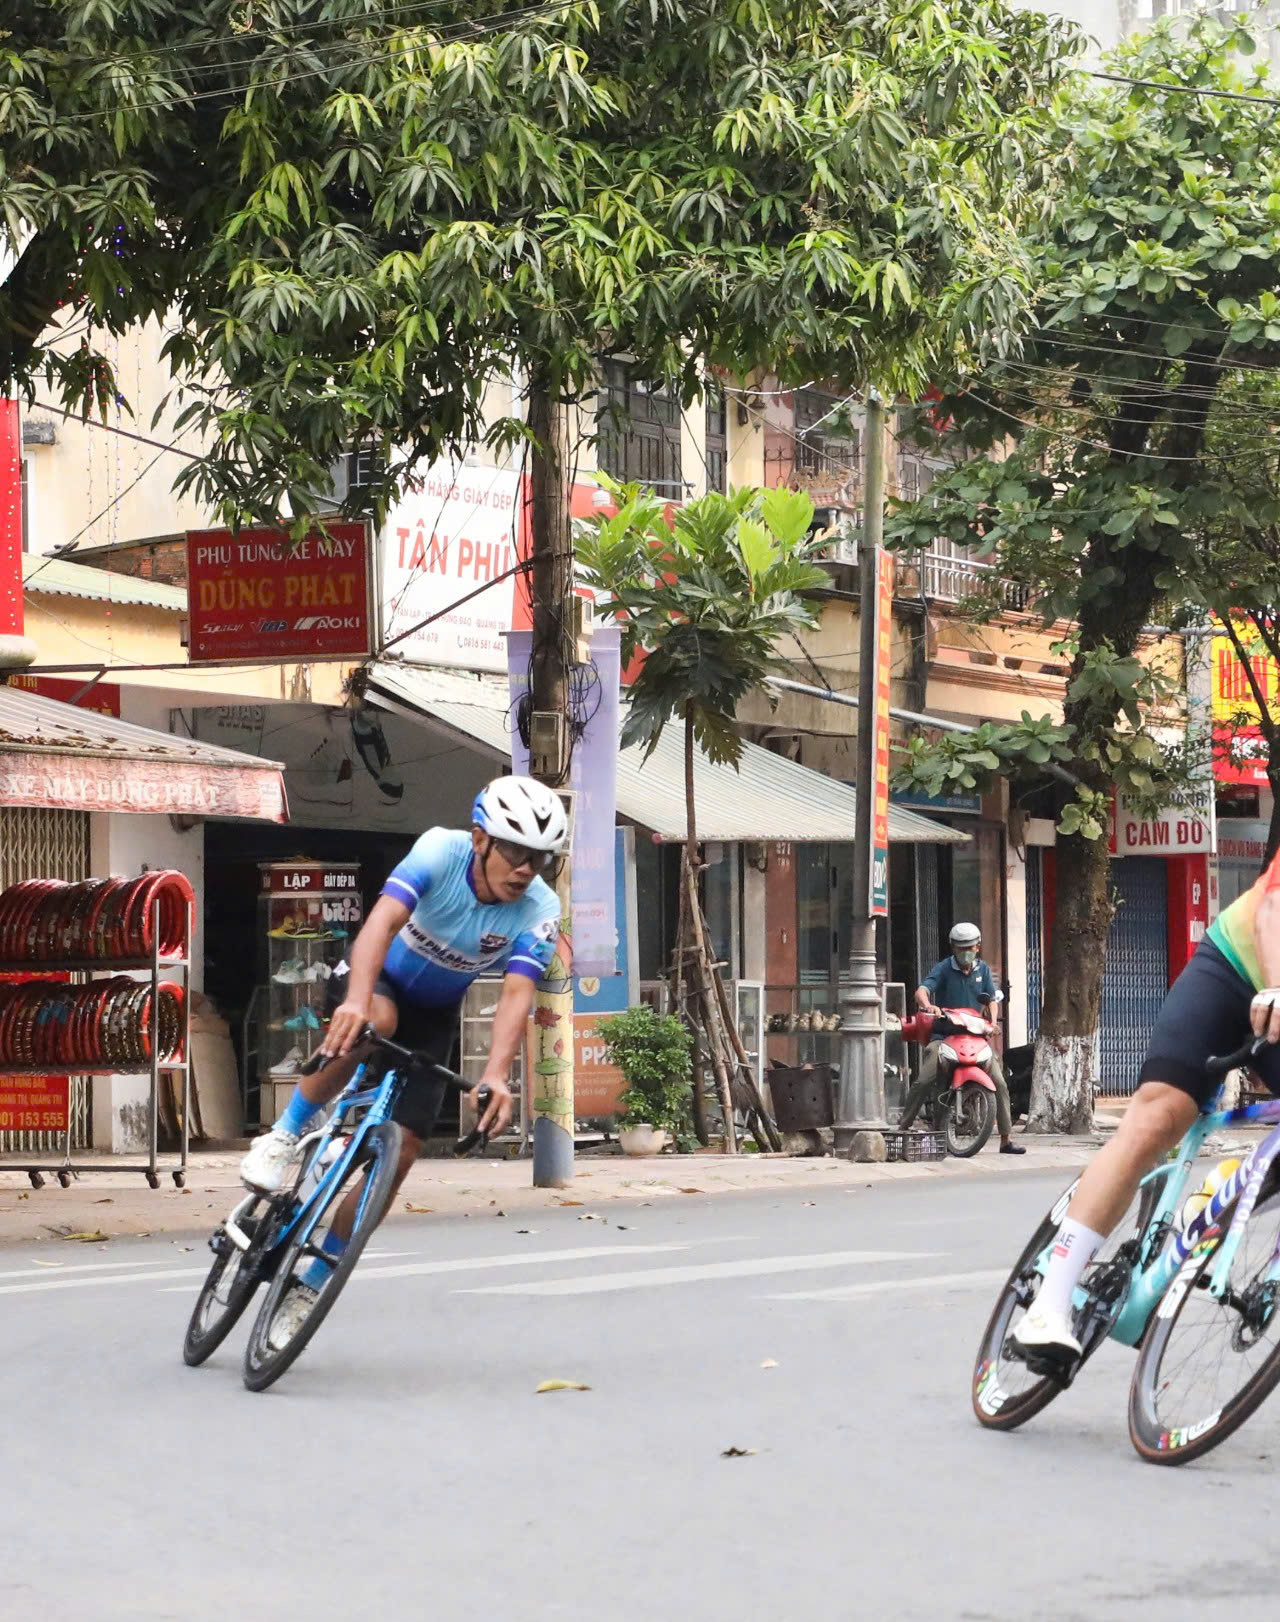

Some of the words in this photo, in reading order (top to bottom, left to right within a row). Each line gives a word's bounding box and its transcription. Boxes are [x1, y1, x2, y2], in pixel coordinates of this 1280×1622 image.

[196, 544, 232, 568] PHỤ
[289, 541, 311, 560] XE
[396, 518, 448, 576] TÂN
[457, 532, 512, 585] PHÚ
[199, 570, 275, 612] DŨNG
[284, 567, 356, 607] PHÁT
[317, 616, 360, 630] AOKI
[283, 873, 311, 890] LẬP
[18, 1112, 40, 1127] 153
[43, 1112, 65, 1127] 555
